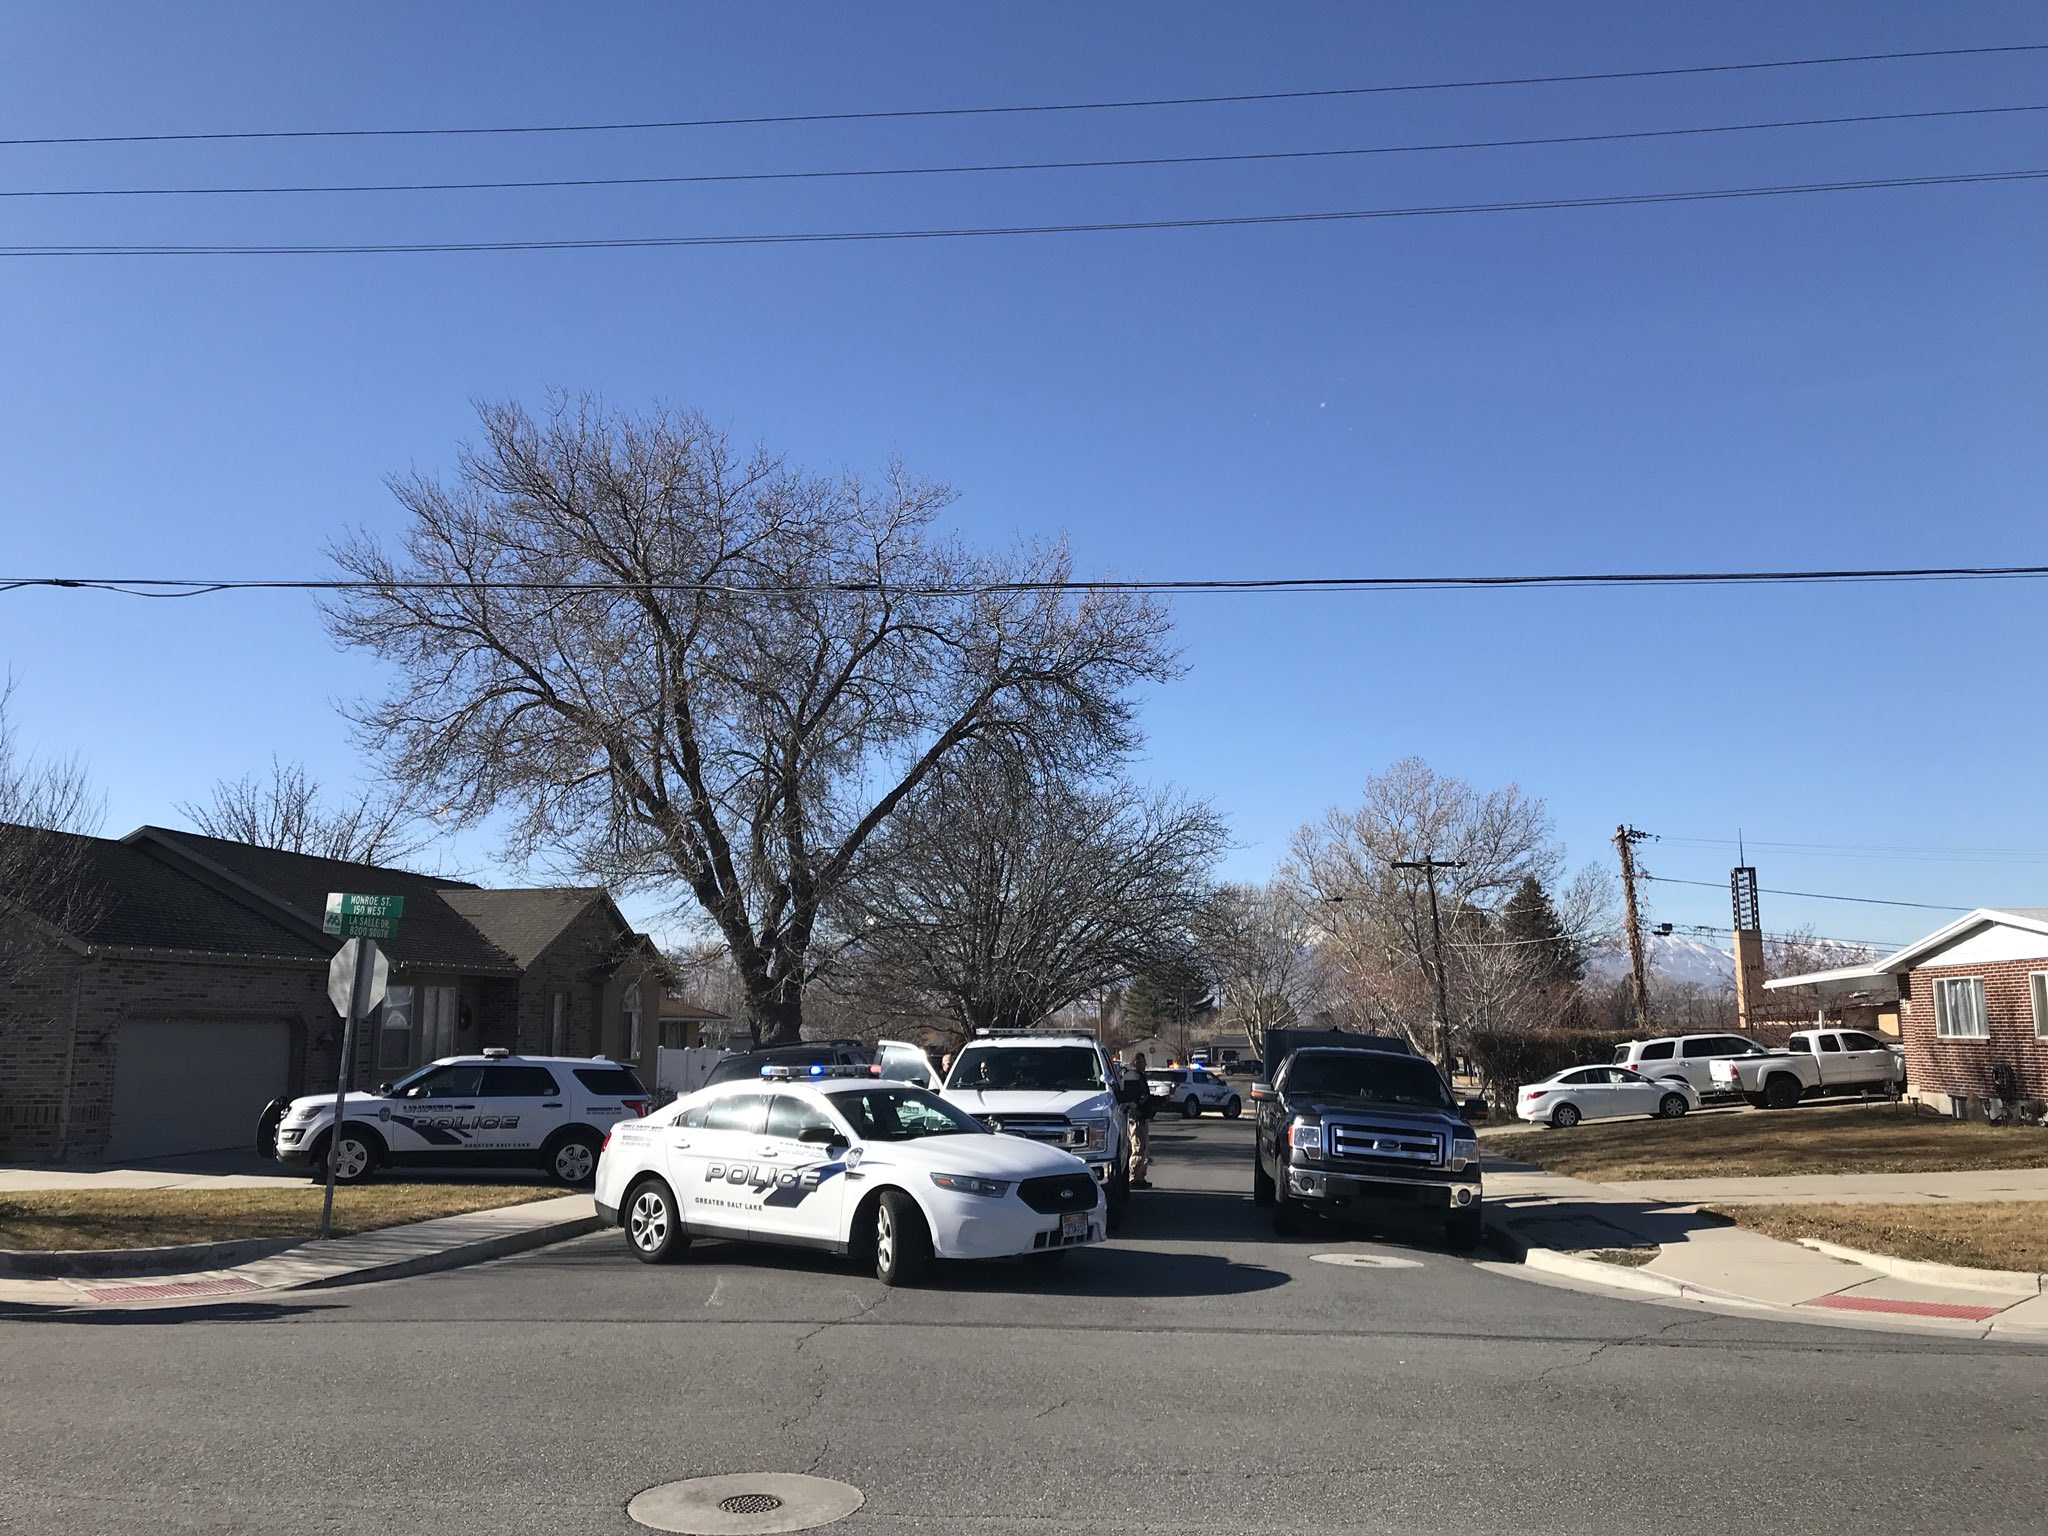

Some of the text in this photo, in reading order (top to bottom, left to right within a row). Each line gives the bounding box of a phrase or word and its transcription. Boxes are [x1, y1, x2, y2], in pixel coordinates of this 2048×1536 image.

[350, 895, 392, 907] MONROE ST.
[367, 906, 387, 916] WEST
[349, 916, 357, 925] LA
[360, 917, 379, 927] SALLE
[349, 925, 389, 938] 8200 SOUTH
[411, 1115, 520, 1130] POLICE
[705, 1162, 820, 1192] POLICE
[695, 1197, 763, 1211] GREATER SALT LAKE
